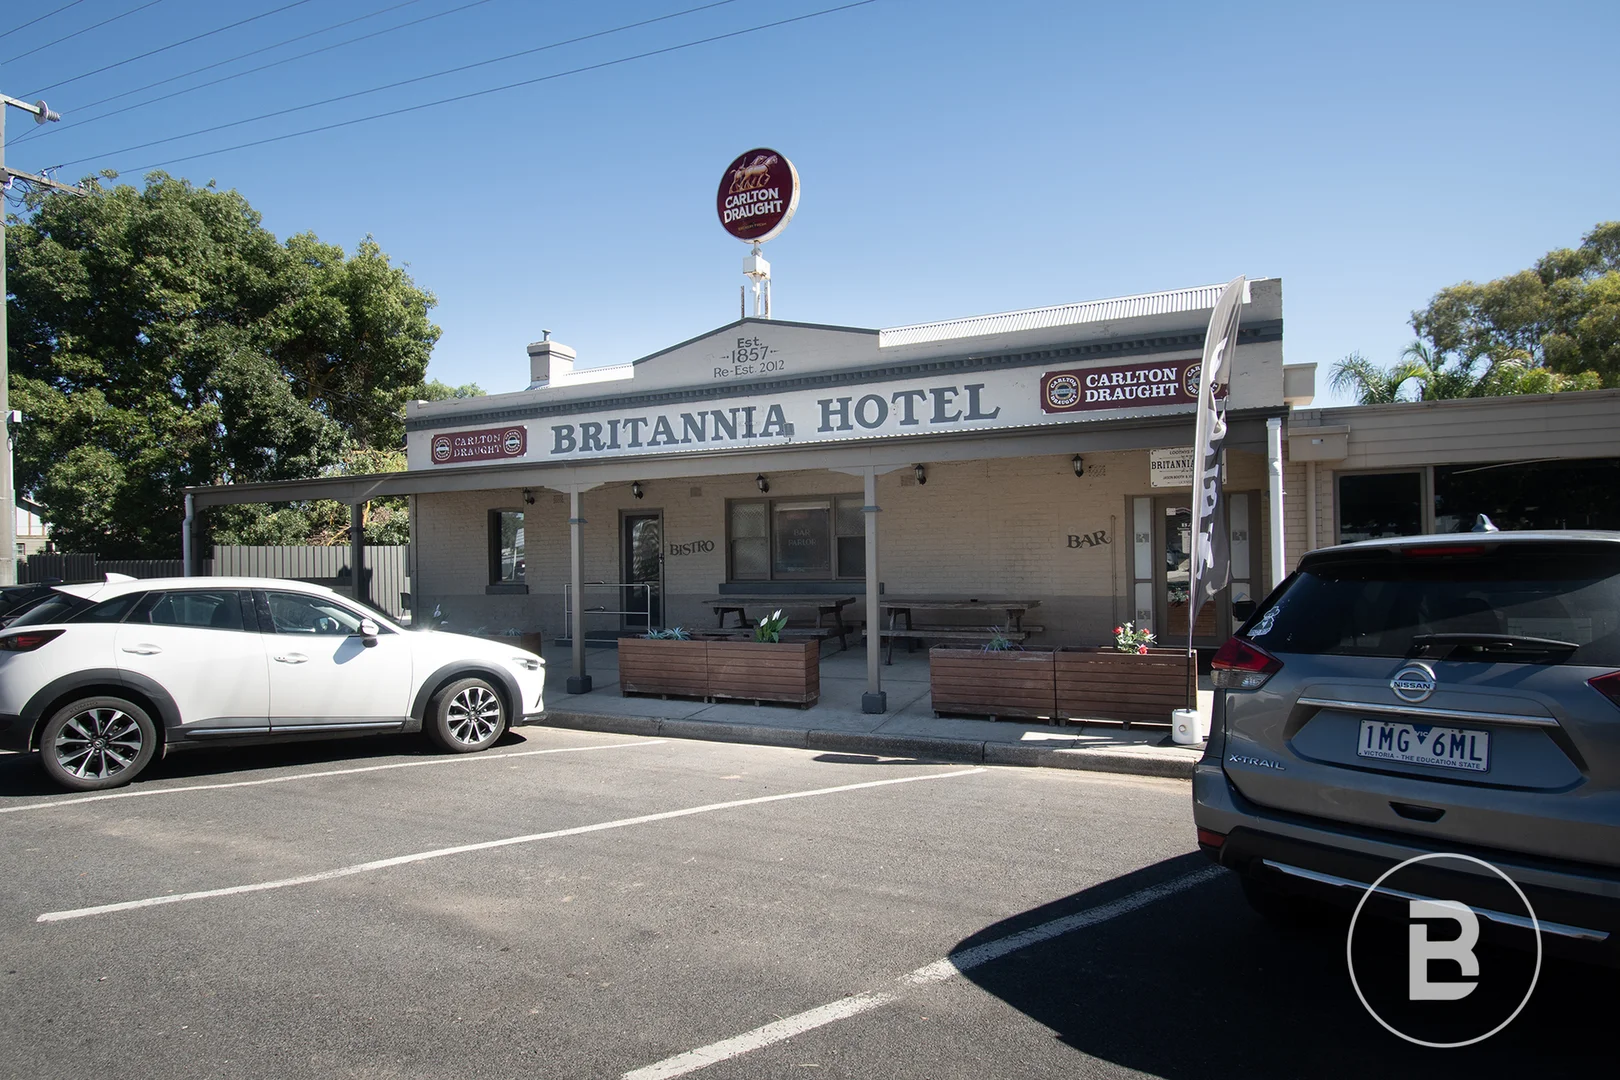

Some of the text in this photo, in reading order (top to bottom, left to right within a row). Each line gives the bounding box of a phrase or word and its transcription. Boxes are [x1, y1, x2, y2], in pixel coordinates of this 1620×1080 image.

[725, 187, 779, 208] CARLTON
[724, 200, 783, 223] DRAUGHT
[737, 337, 762, 348] Est.
[732, 346, 768, 363] 1857
[714, 360, 784, 378] Re-Est. 2012
[1086, 367, 1177, 388] CARLTON
[1050, 377, 1077, 388] CARLTON
[1051, 394, 1077, 405] DRAUGHT
[1085, 382, 1178, 403] DRAUGHT
[550, 383, 1001, 454] BRITANNIA HOTEL
[454, 434, 500, 446] CARLTON
[454, 445, 501, 457] DRAUGHT
[793, 528, 811, 536] BAR
[1066, 530, 1112, 549] BAR
[670, 540, 715, 556] BISTRO
[1394, 681, 1430, 689] NISSAN
[1367, 725, 1482, 761] 1MG 6ML
[1229, 754, 1286, 771] X-TRAIL
[1363, 750, 1395, 759] VICTORIA
[1416, 756, 1457, 767] EDUCATION
[1458, 761, 1481, 770] STATE
